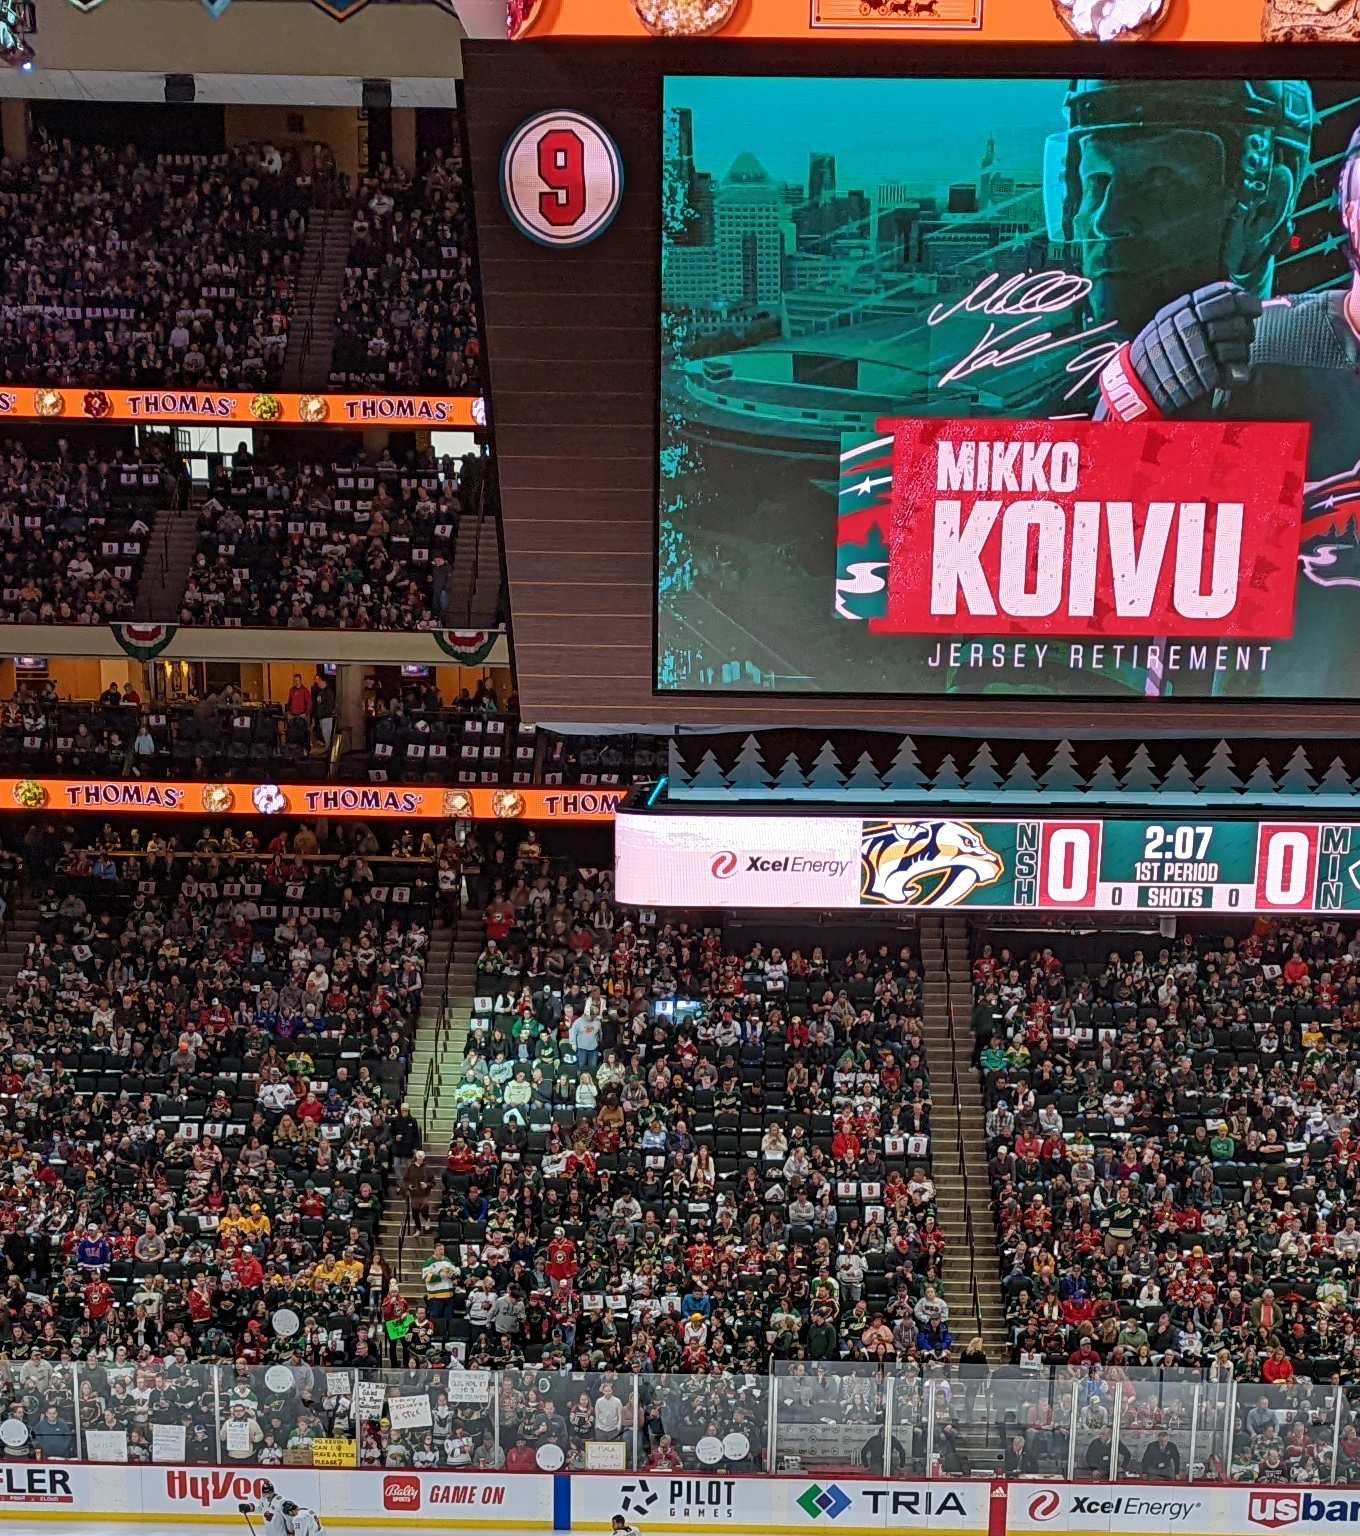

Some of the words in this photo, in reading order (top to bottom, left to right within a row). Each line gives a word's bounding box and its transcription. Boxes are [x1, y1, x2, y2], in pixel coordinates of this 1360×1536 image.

[539, 129, 586, 226] 9
[936, 441, 1080, 493] MIKKO
[930, 500, 1244, 619] KOIVU
[928, 642, 1058, 668] JERSEY
[1070, 643, 1272, 671] RETIREMENT
[1144, 825, 1214, 860] 2:07
[745, 857, 789, 874] Xcel
[790, 857, 847, 879] Energy
[1047, 828, 1091, 902] 0
[1134, 862, 1161, 882] 1ST
[1164, 862, 1219, 882] PERIOD
[1265, 831, 1310, 905] 0
[1111, 887, 1122, 906] 0
[1147, 887, 1203, 908] SHOTS
[1228, 888, 1240, 907] 0
[429, 1485, 476, 1505] GAME
[481, 1486, 506, 1506] ON
[670, 1480, 735, 1505] PILOT
[862, 1490, 967, 1516] TRIA
[670, 1508, 733, 1518] GAMES
[1070, 1496, 1121, 1514] Xcel
[1124, 1497, 1194, 1521] Energy
